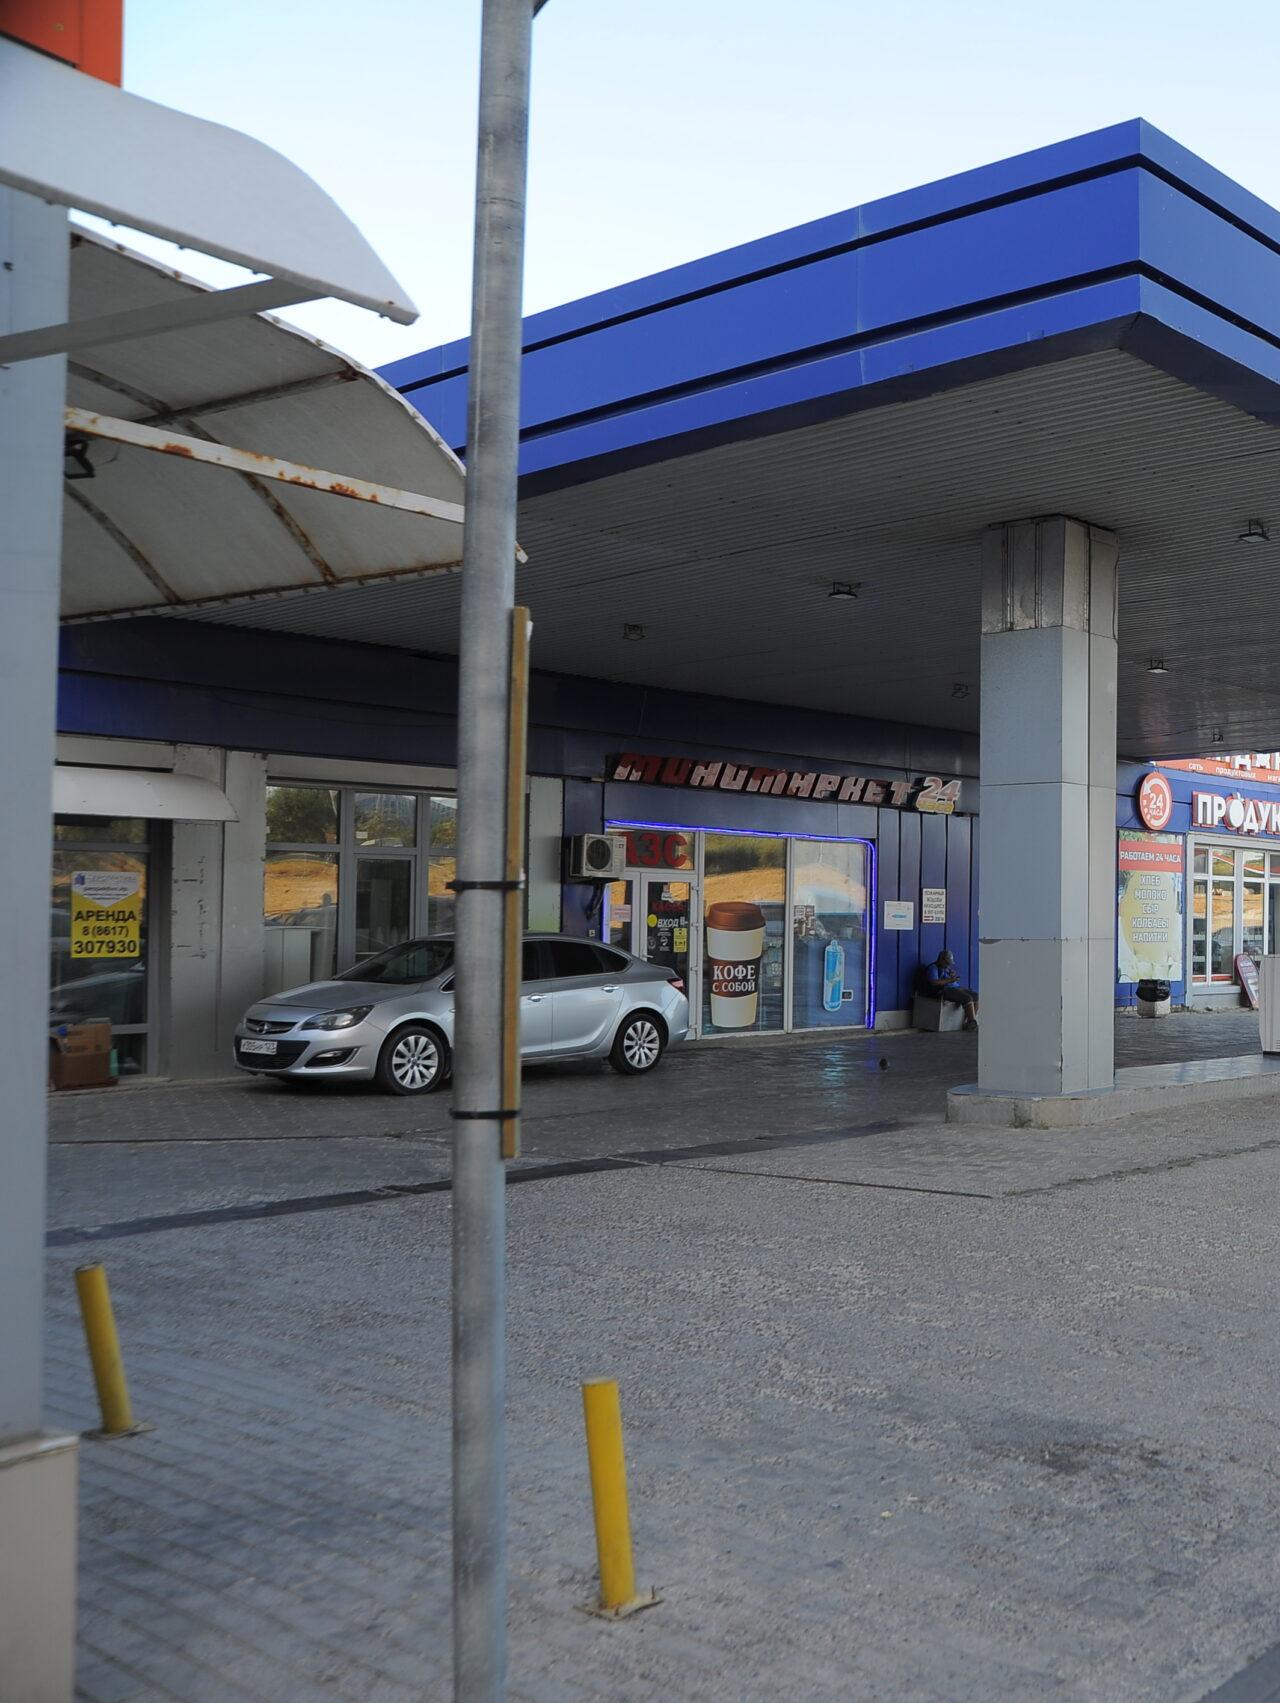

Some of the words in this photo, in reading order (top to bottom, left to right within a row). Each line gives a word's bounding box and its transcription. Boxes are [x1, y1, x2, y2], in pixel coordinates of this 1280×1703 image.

[918, 777, 962, 802] 24
[1149, 792, 1163, 808] 24
[1120, 850, 1155, 861] РАБОТАЕМ
[1156, 853, 1164, 862] 24
[1165, 855, 1182, 863] ЧАСА
[1141, 875, 1160, 886] ХЛЕБ
[1135, 890, 1168, 900] МОЛОКО
[1143, 903, 1159, 914] СЫР
[74, 910, 137, 923] АРЕНДА
[657, 918, 679, 928] ВХОД
[1132, 918, 1169, 928] КОЛБАСЫ
[82, 926, 90, 936] 8
[92, 925, 129, 938] (8617)
[1132, 932, 1169, 943] НАПИТКИ
[74, 940, 137, 954] 307930
[713, 965, 756, 980] КОФЕ
[712, 982, 720, 992] С
[721, 980, 756, 992] СОБОЙ
